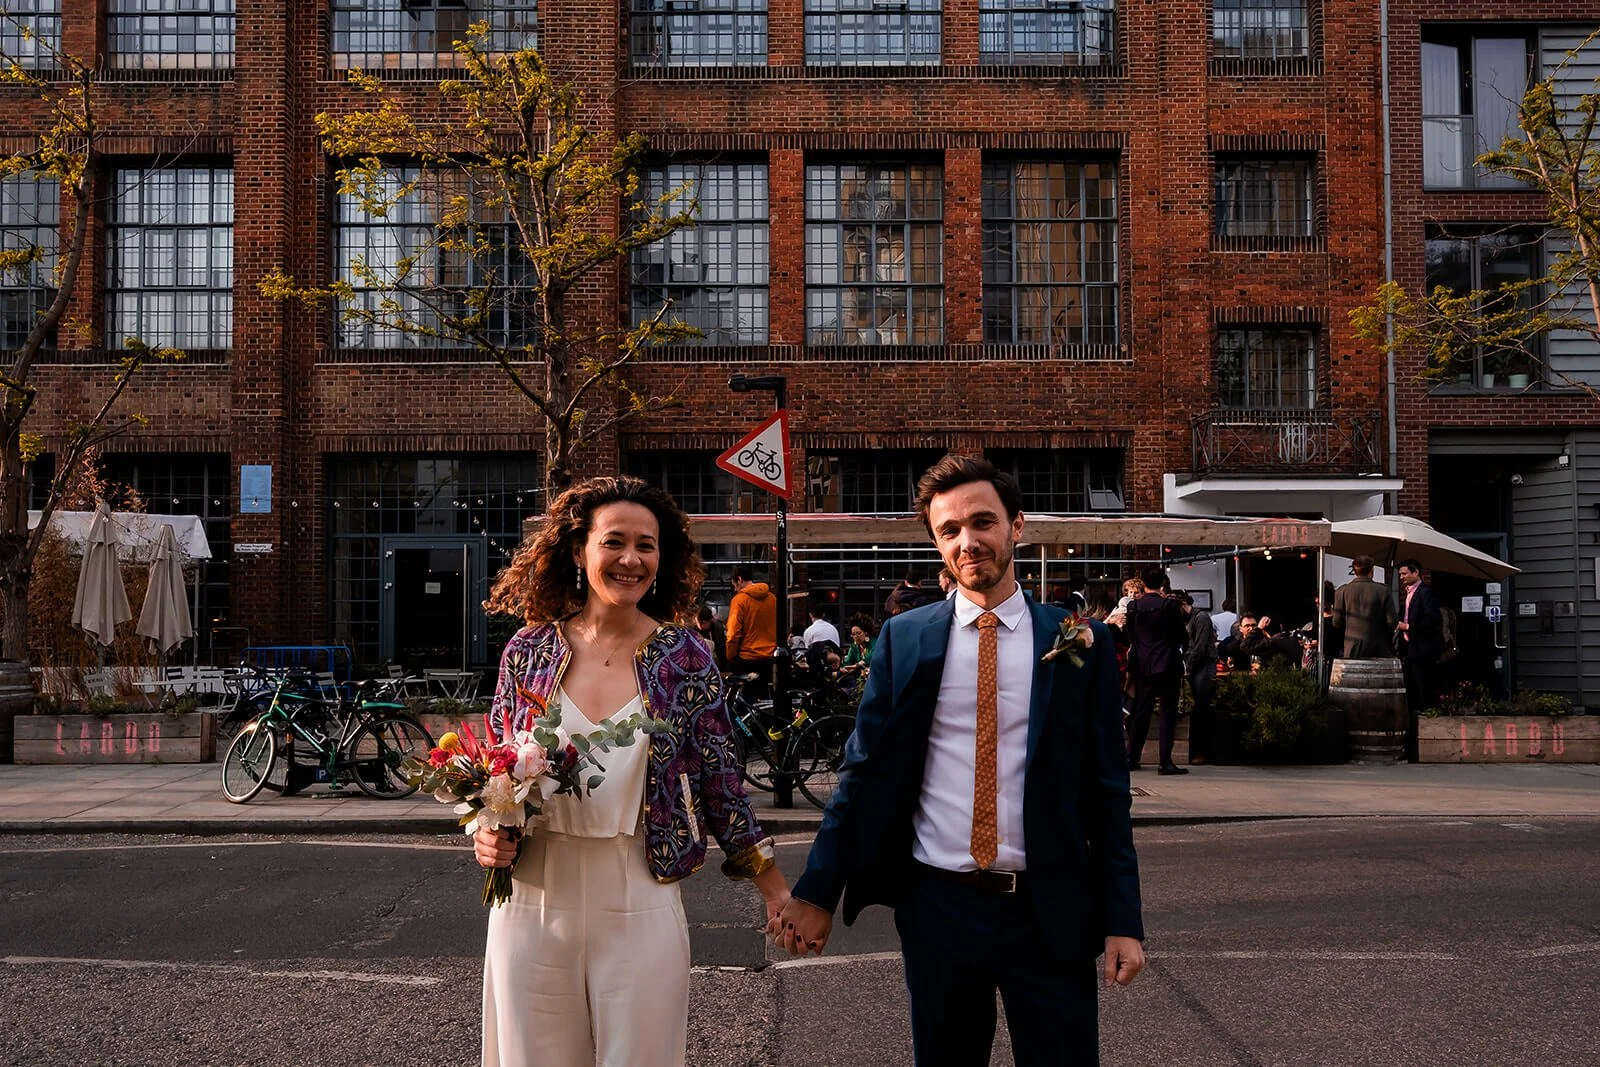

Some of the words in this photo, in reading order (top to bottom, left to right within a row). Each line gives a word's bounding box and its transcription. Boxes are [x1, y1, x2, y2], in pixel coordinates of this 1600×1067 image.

[56, 721, 160, 755] LARDO
[1460, 722, 1564, 756] LARDO
[319, 770, 326, 780] P
